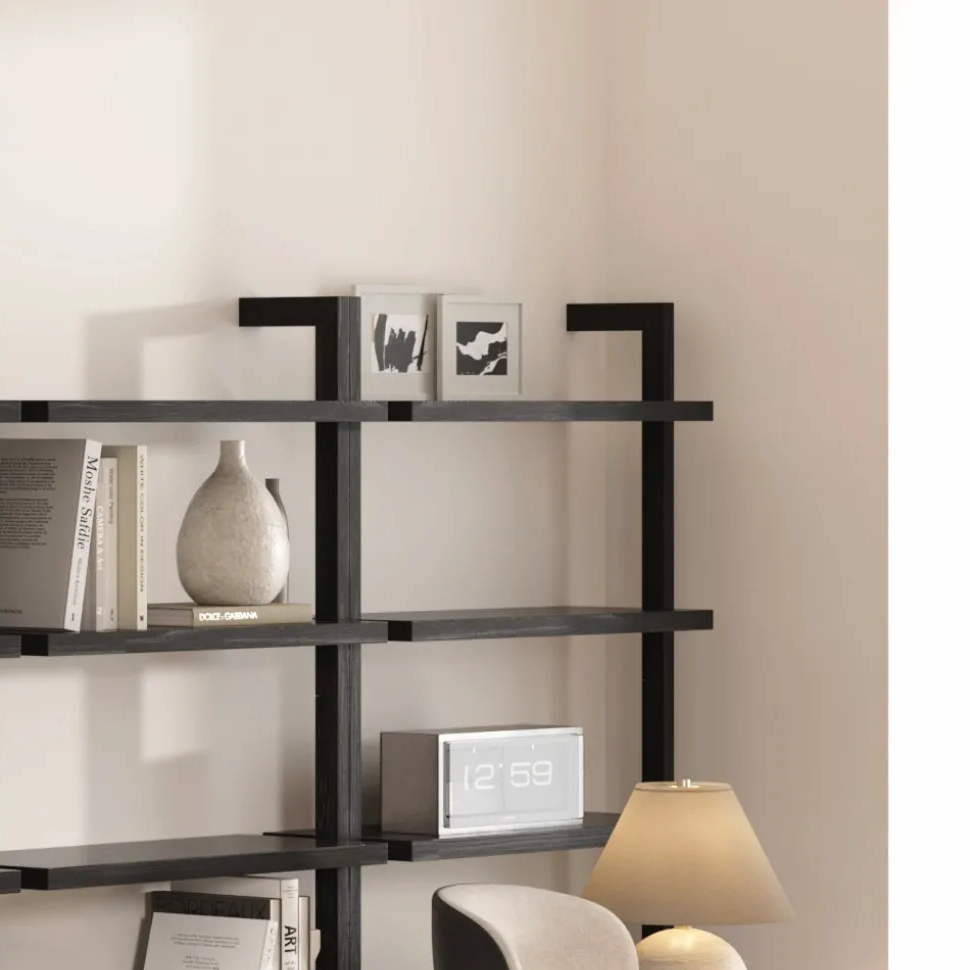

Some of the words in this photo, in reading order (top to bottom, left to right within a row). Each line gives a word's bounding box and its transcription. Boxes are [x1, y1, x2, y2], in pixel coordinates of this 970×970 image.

[83, 455, 99, 503] Moshe
[77, 507, 93, 550] Safdie
[284, 925, 297, 954] ART
